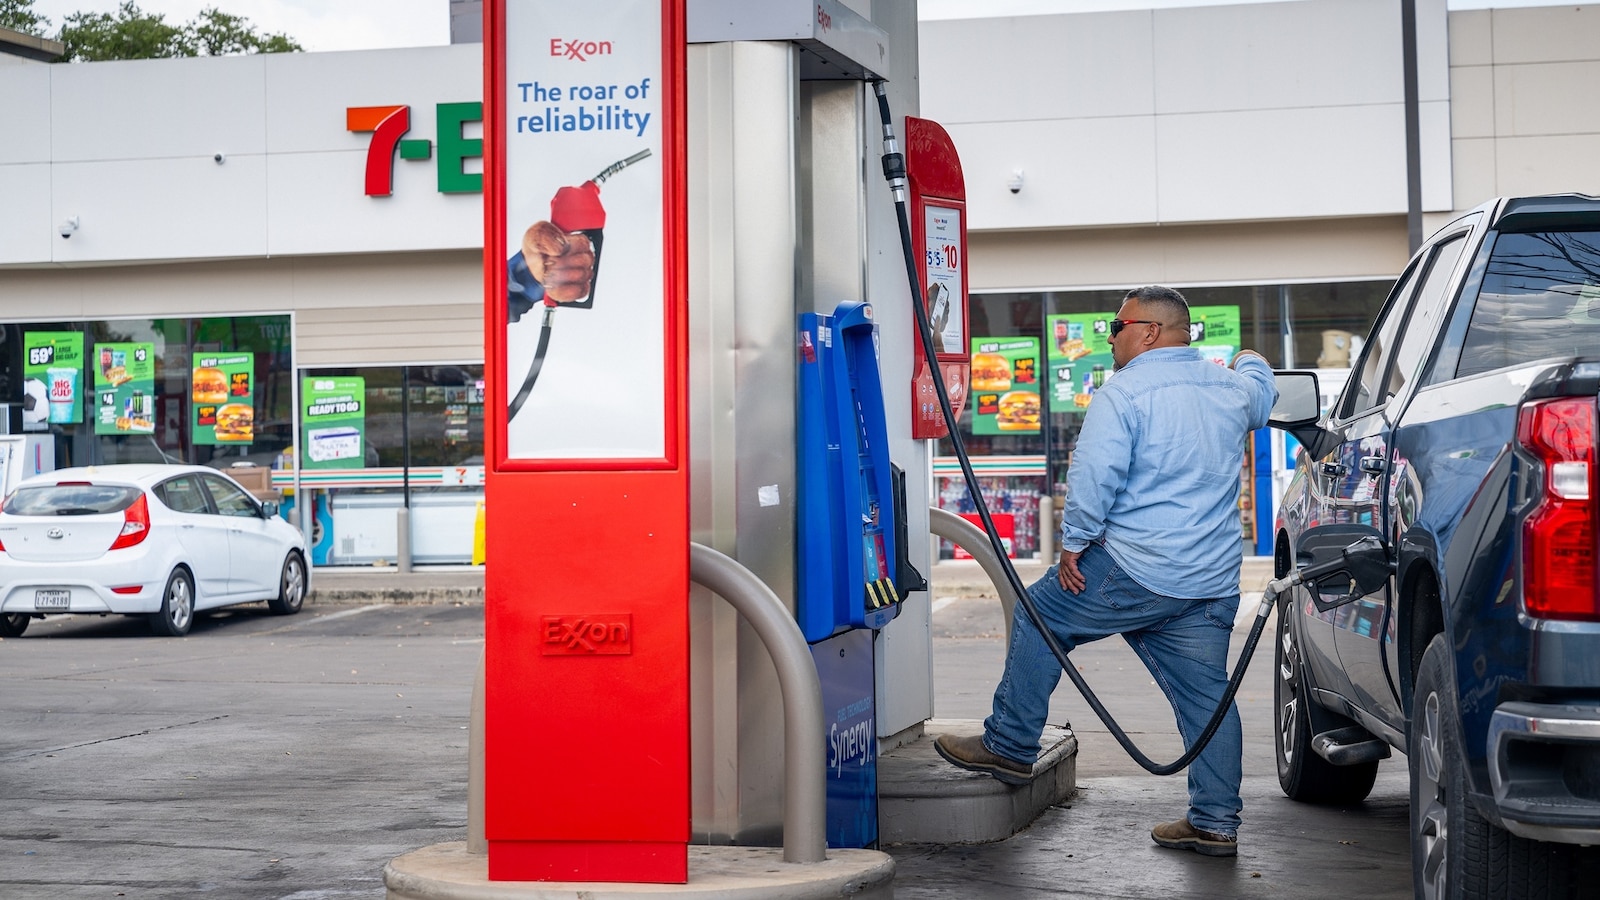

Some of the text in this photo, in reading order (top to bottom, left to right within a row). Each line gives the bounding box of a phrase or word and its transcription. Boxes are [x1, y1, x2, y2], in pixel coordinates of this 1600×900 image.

[550, 38, 612, 61] Exxon
[517, 78, 650, 102] The roar of
[517, 105, 651, 137] reliability
[51, 389, 72, 397] GULP
[309, 402, 359, 415] READY TO GO
[544, 617, 628, 651] Exxon
[830, 718, 873, 778] Synergy
